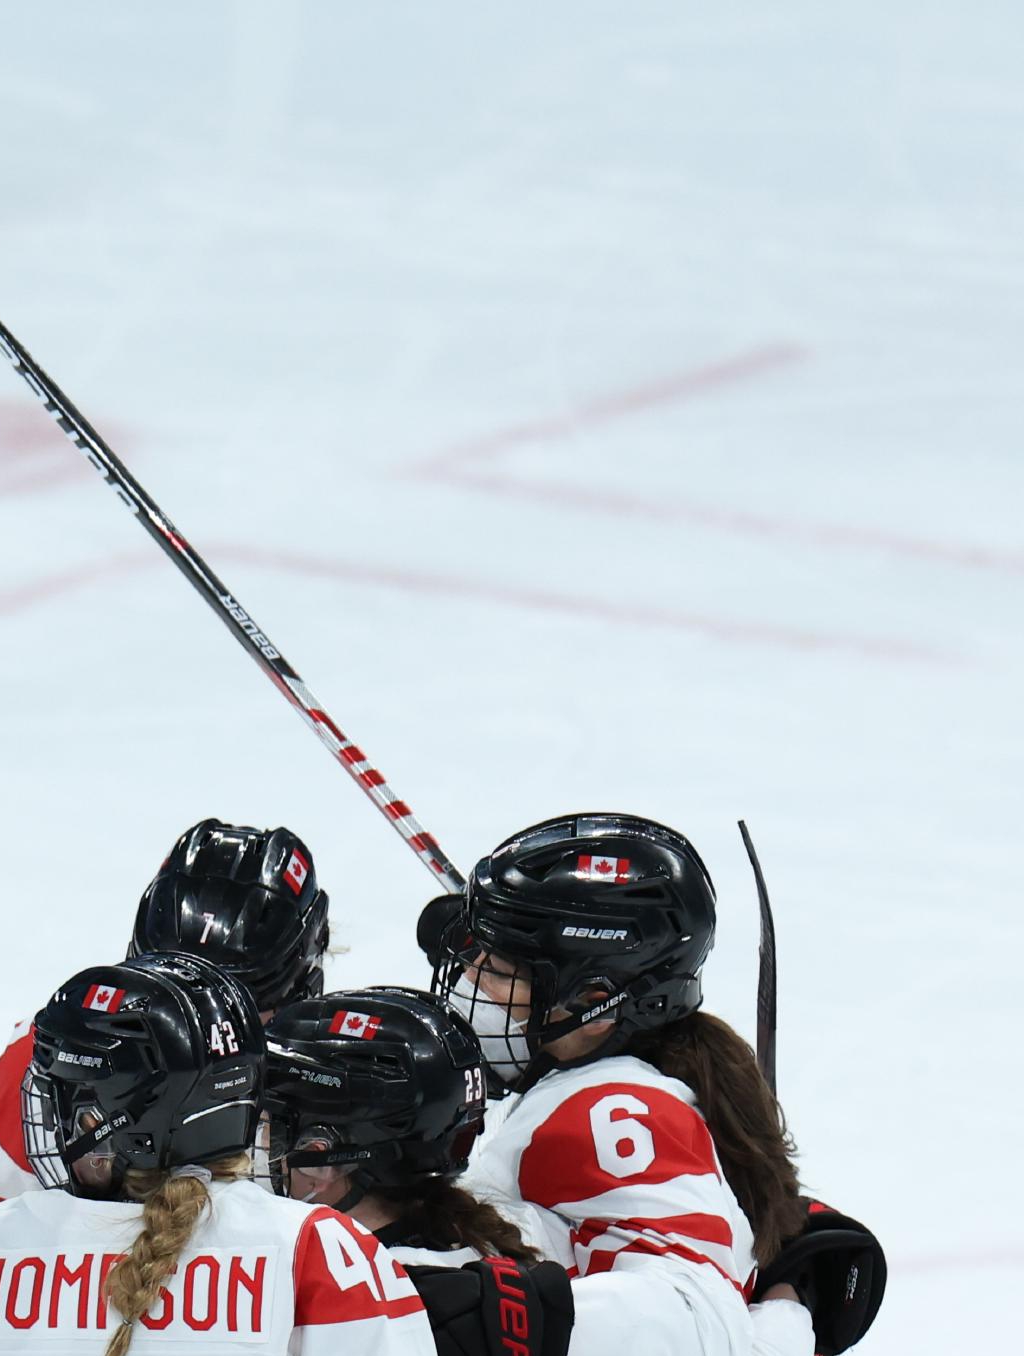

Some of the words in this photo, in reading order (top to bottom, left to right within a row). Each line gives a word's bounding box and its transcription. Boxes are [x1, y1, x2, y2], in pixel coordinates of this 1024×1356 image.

[219, 595, 281, 660] BAUER
[200, 912, 216, 944] 7
[561, 926, 628, 941] BAUER
[581, 991, 628, 1024] BAUER
[210, 1019, 240, 1056] 42
[57, 1051, 103, 1068] BAUER
[464, 1067, 485, 1103] 23
[588, 1093, 656, 1179] 6
